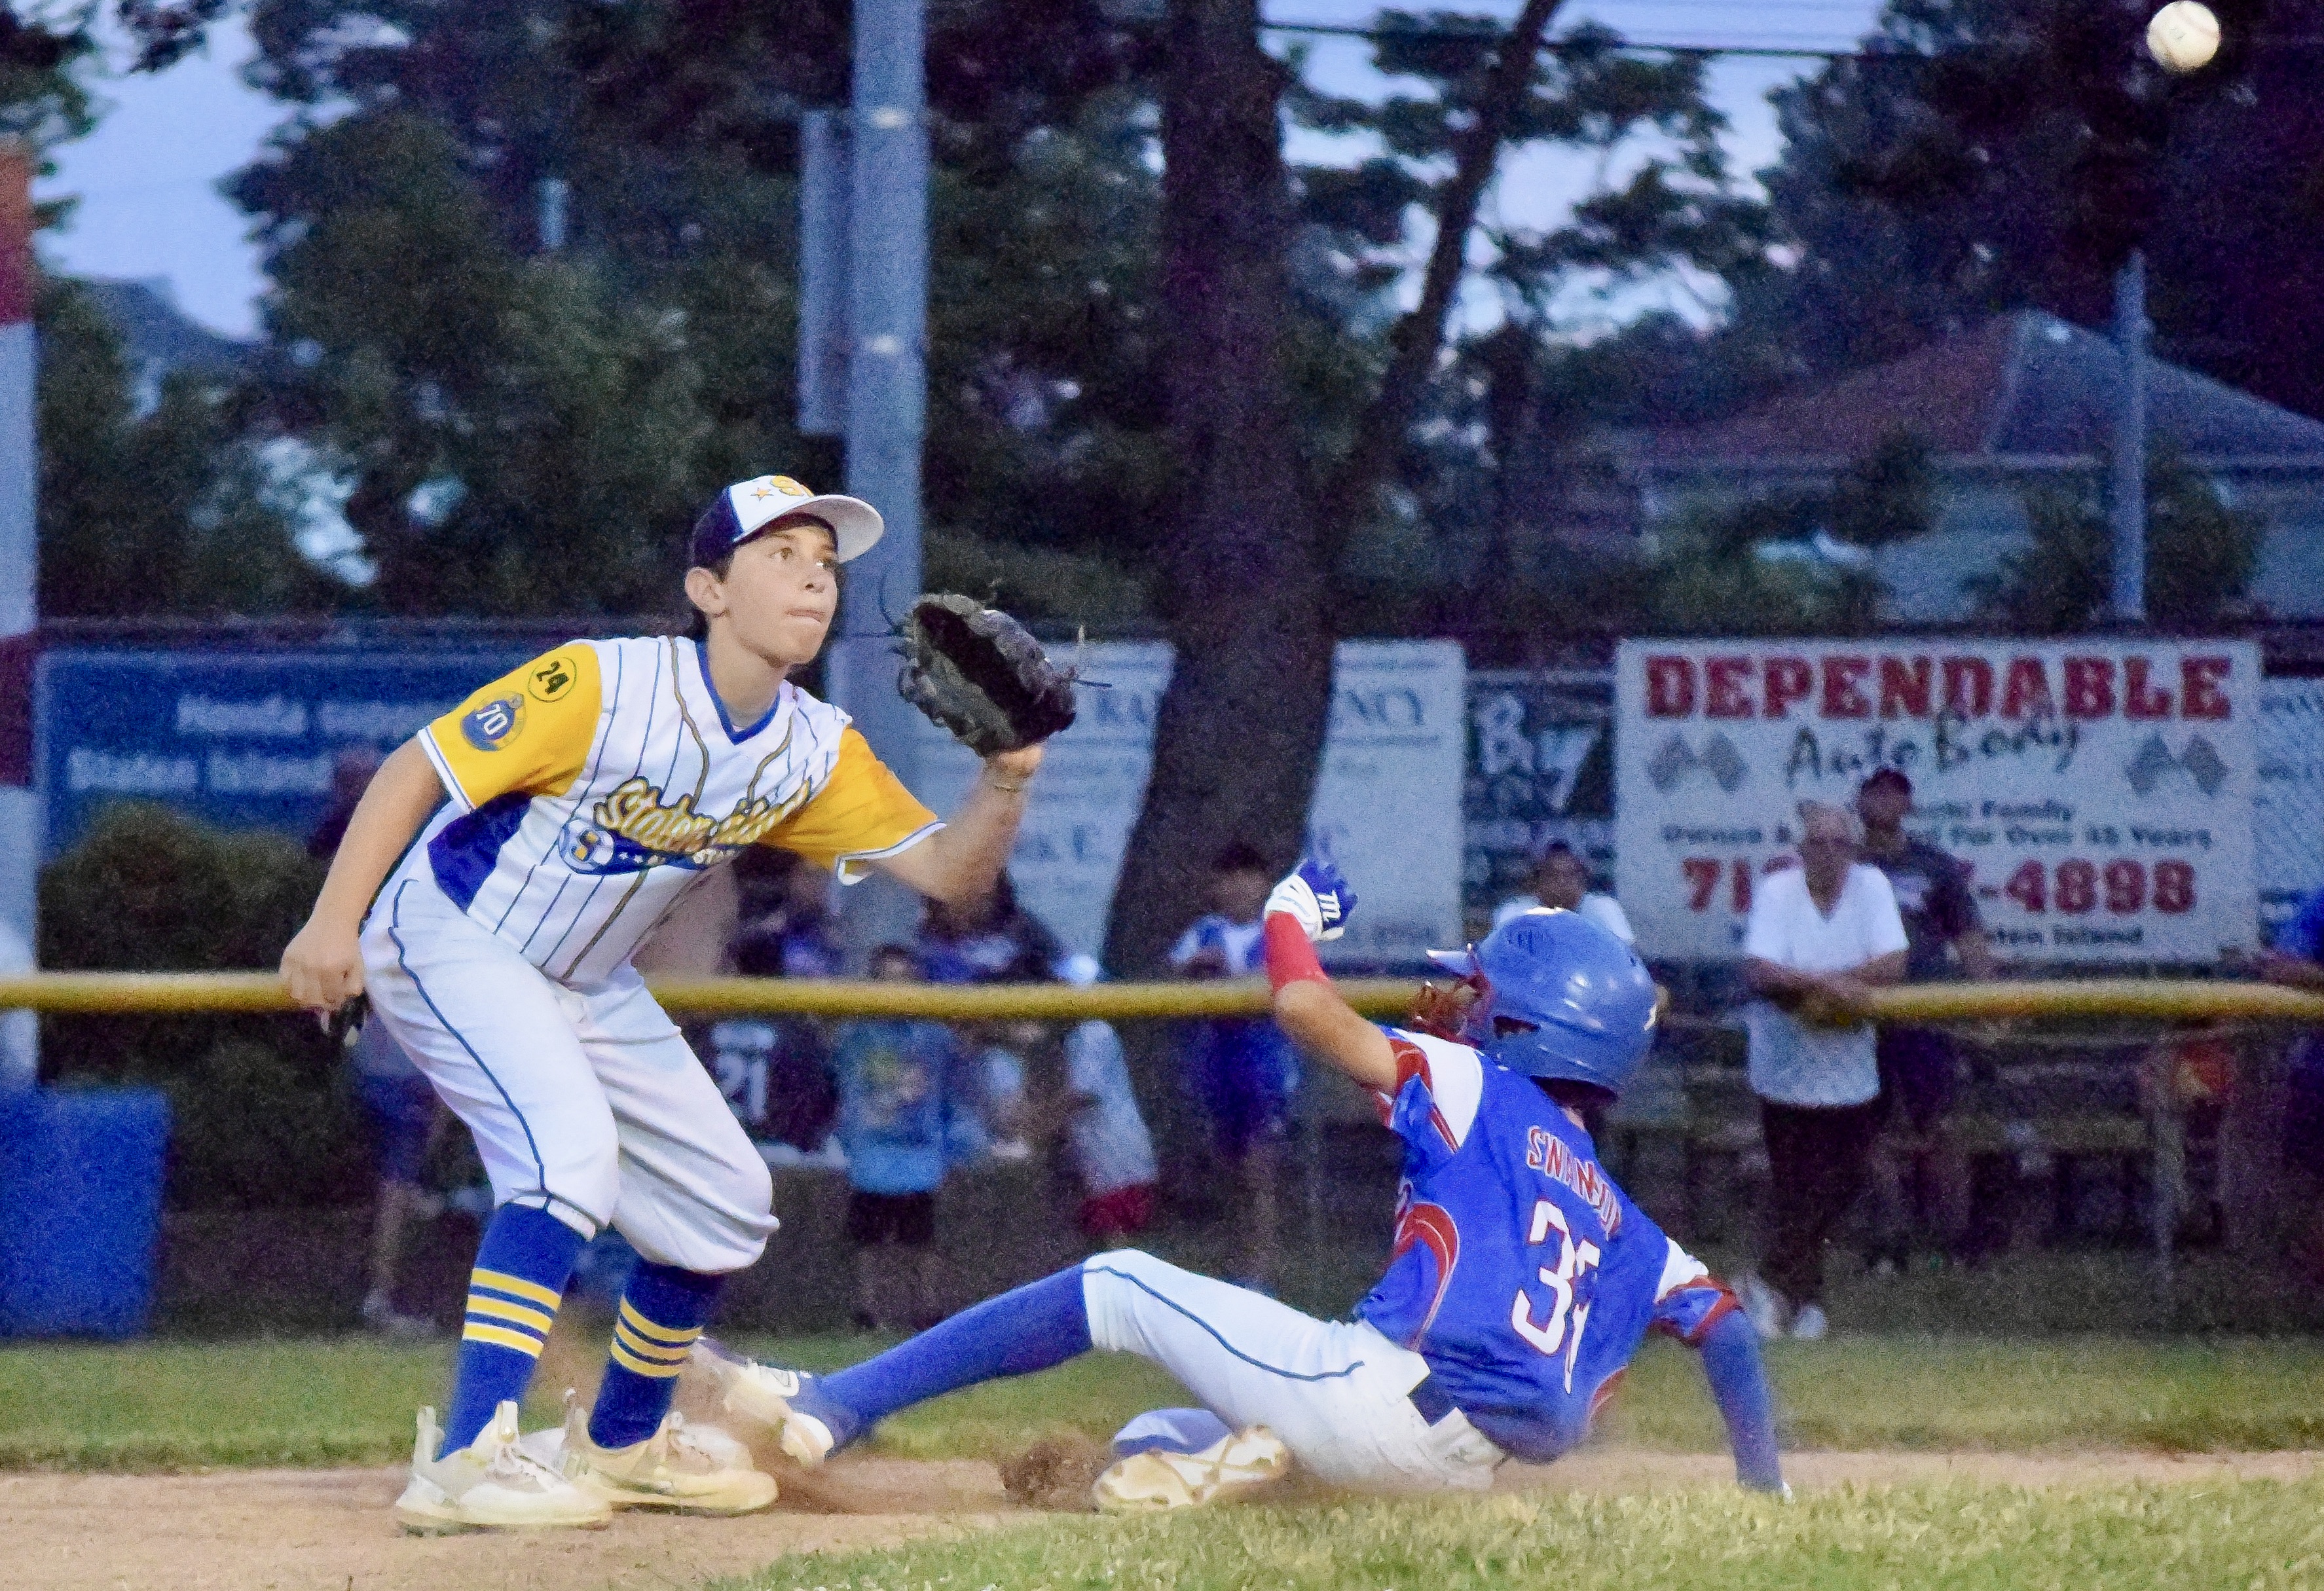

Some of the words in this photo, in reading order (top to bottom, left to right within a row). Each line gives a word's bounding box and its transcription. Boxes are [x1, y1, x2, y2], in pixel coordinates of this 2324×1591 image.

[536, 660, 570, 695] 24
[1645, 655, 2232, 720] DEPENDABLE
[476, 704, 508, 735] 70
[1784, 724, 1920, 788] Auto
